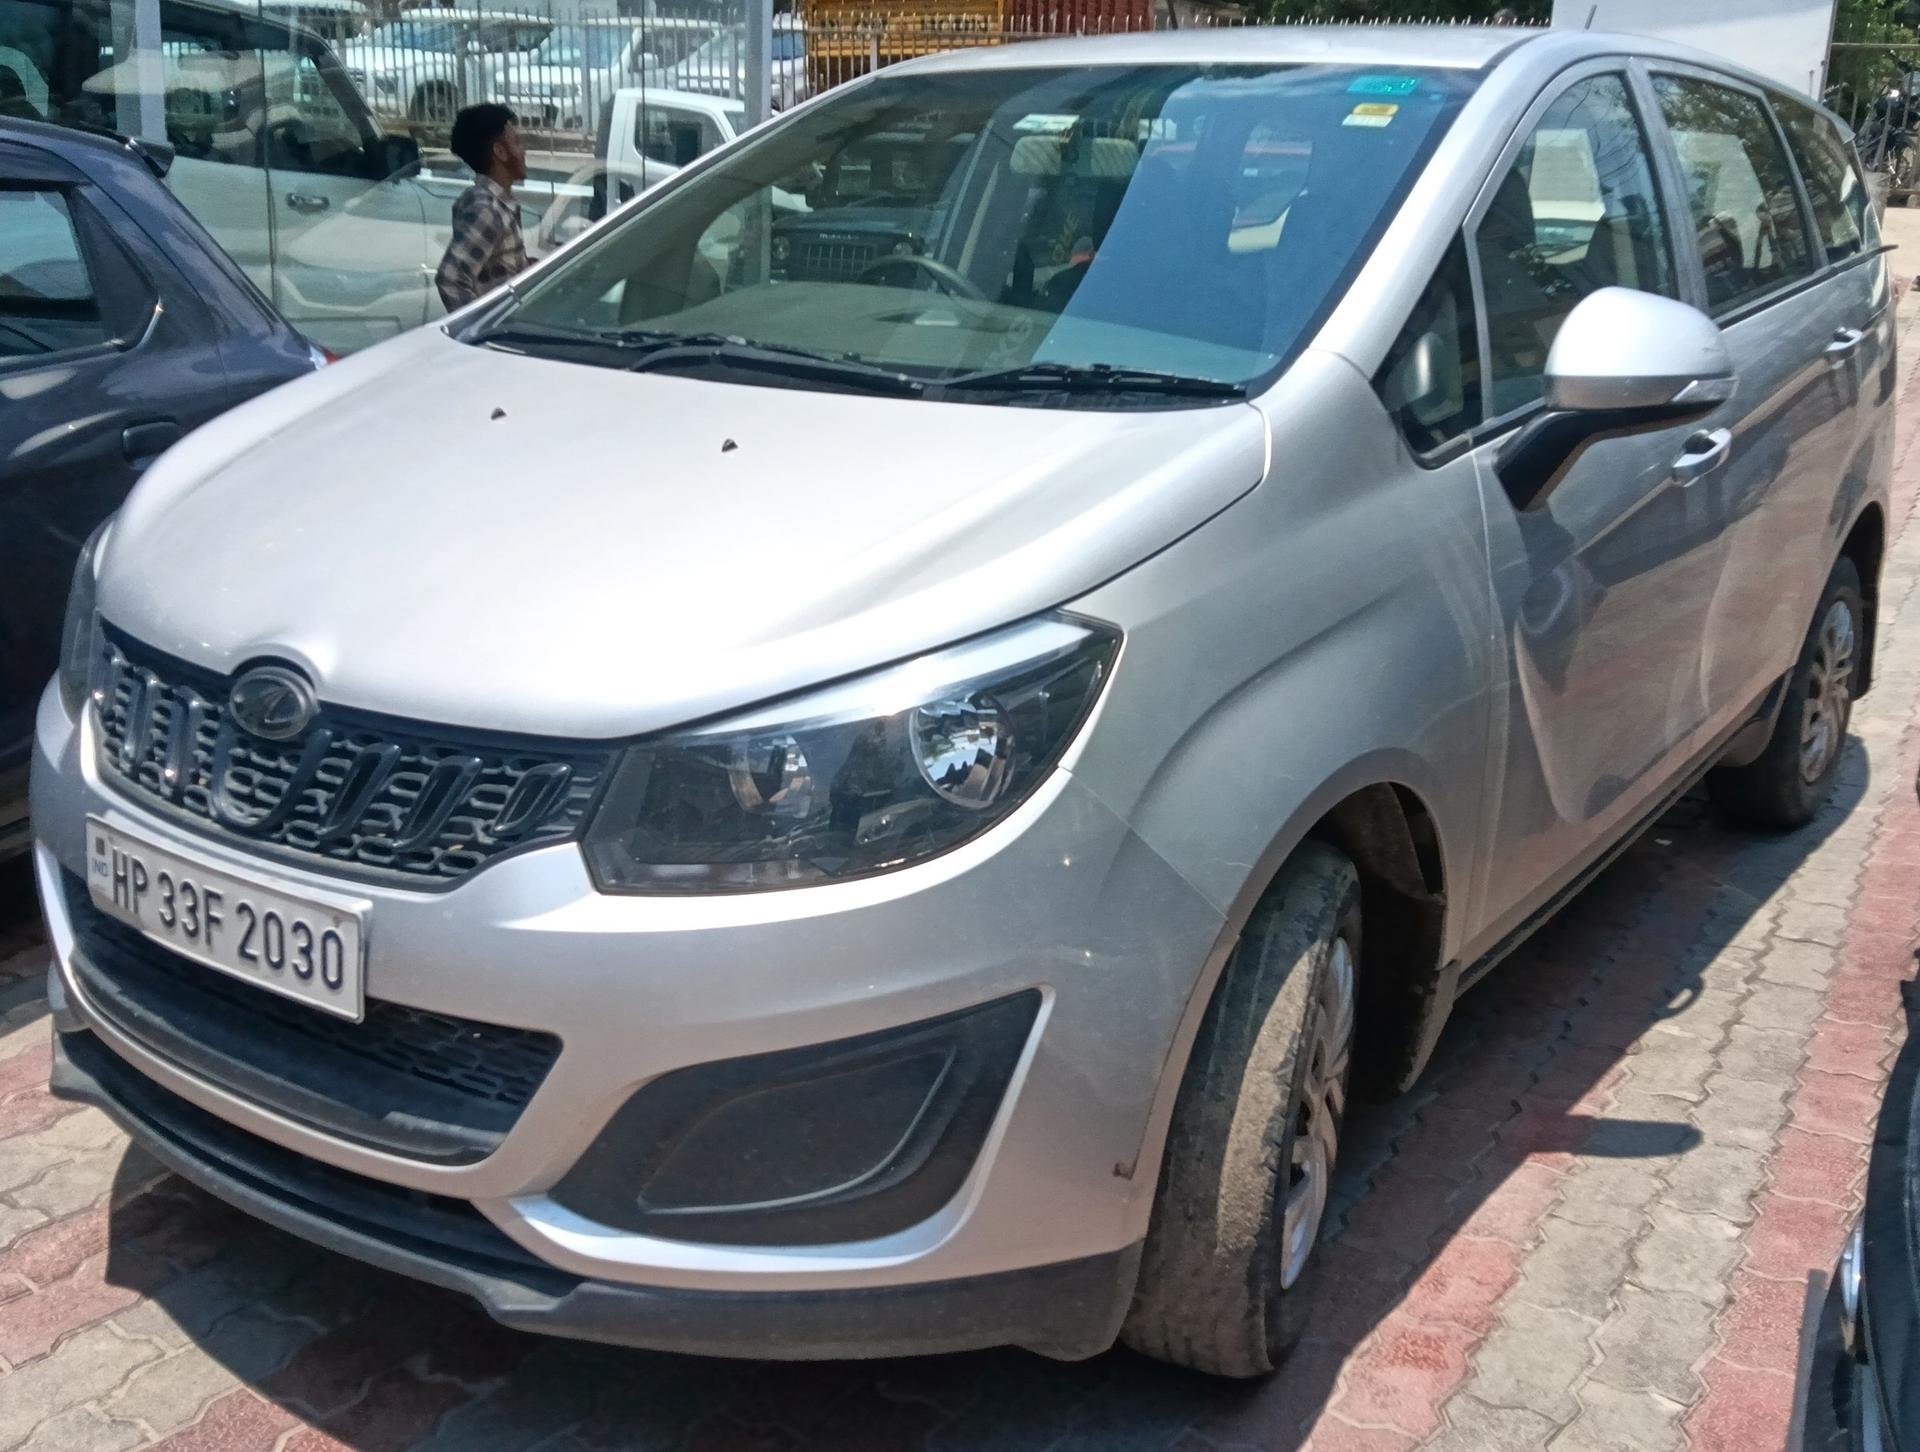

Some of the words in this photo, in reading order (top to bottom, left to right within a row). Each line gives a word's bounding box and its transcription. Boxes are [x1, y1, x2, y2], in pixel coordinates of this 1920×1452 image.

[112, 846, 148, 914] HP
[157, 871, 223, 945] 33F
[236, 901, 344, 990] 2030
